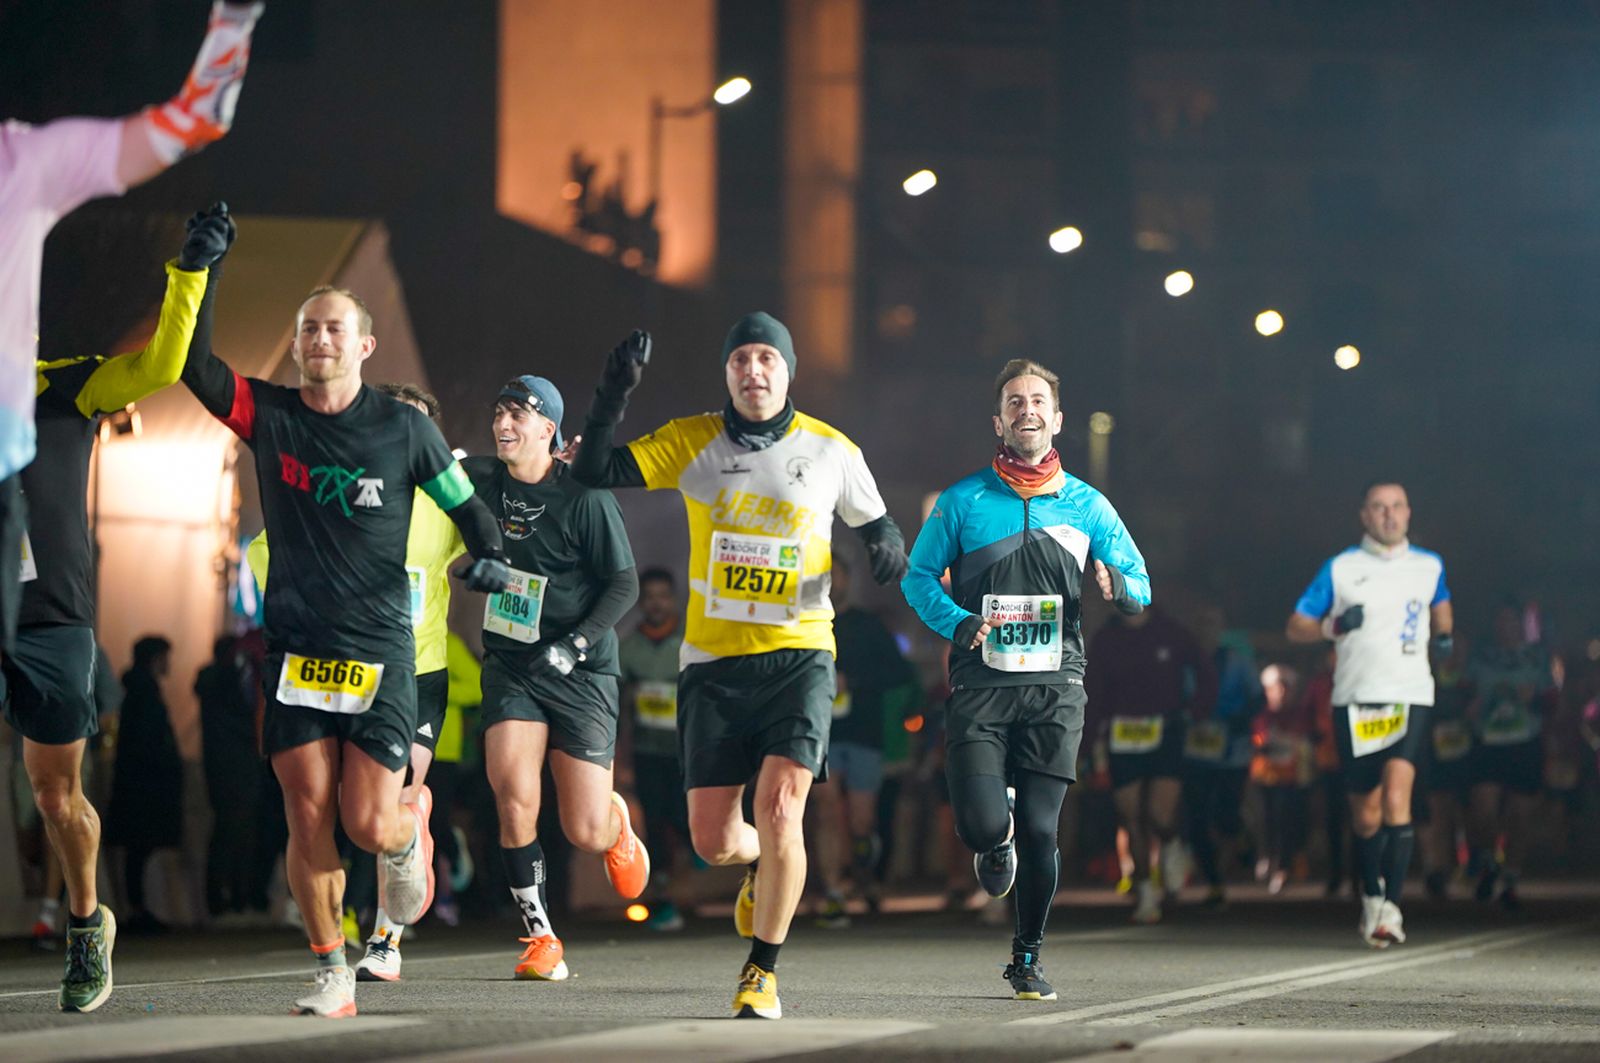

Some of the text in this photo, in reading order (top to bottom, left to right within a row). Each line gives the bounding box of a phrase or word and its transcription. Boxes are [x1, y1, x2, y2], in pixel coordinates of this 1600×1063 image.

[720, 553, 736, 562] SAN
[723, 564, 788, 595] 12577
[1000, 604, 1022, 612] NOCHE
[1023, 603, 1033, 612] DE
[995, 622, 1052, 646] 13370
[300, 659, 365, 688] 6566
